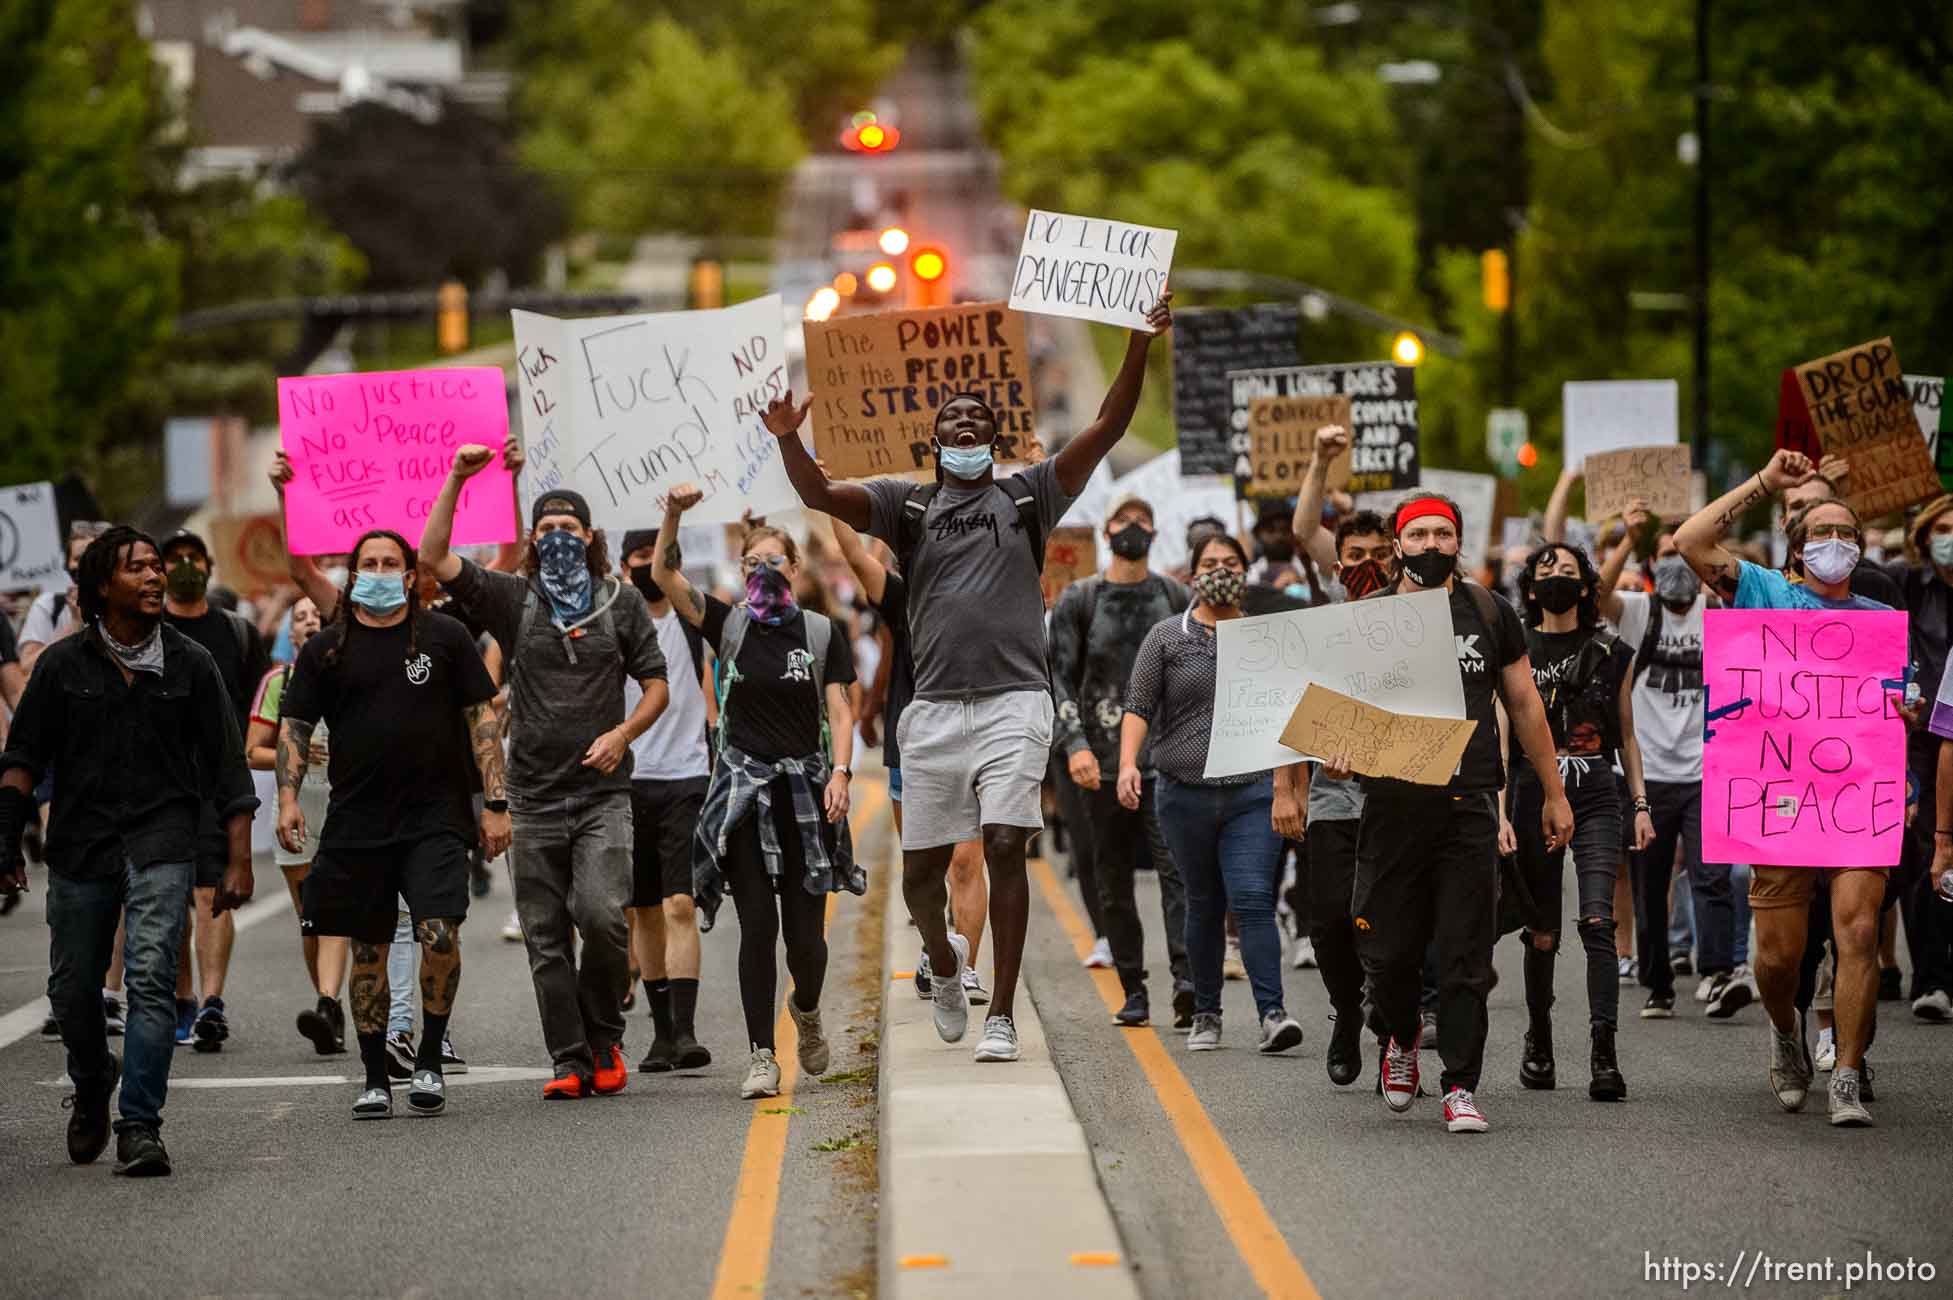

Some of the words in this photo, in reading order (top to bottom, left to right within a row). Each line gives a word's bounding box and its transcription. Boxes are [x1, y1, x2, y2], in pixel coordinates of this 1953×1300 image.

[1029, 213, 1063, 244] DO
[1072, 220, 1093, 248] I
[1105, 225, 1159, 262] LOOK
[897, 310, 1009, 351] POWER
[731, 336, 768, 377] NO
[860, 362, 896, 386] the
[905, 350, 1016, 384] PEOPLE
[1805, 343, 1892, 400] DROP
[289, 387, 334, 419] No
[532, 389, 556, 416] 12
[1344, 367, 1398, 402] DOES
[1808, 393, 1850, 426] THE
[301, 427, 347, 458] No
[373, 415, 457, 447] Peace
[1361, 425, 1400, 447] AND
[333, 503, 377, 528] ass
[1762, 621, 1855, 662] NO
[1461, 660, 1485, 672] YM
[1720, 667, 1904, 721] JUSTICE
[1760, 730, 1853, 774] NO
[1727, 777, 1901, 838] PEACE
